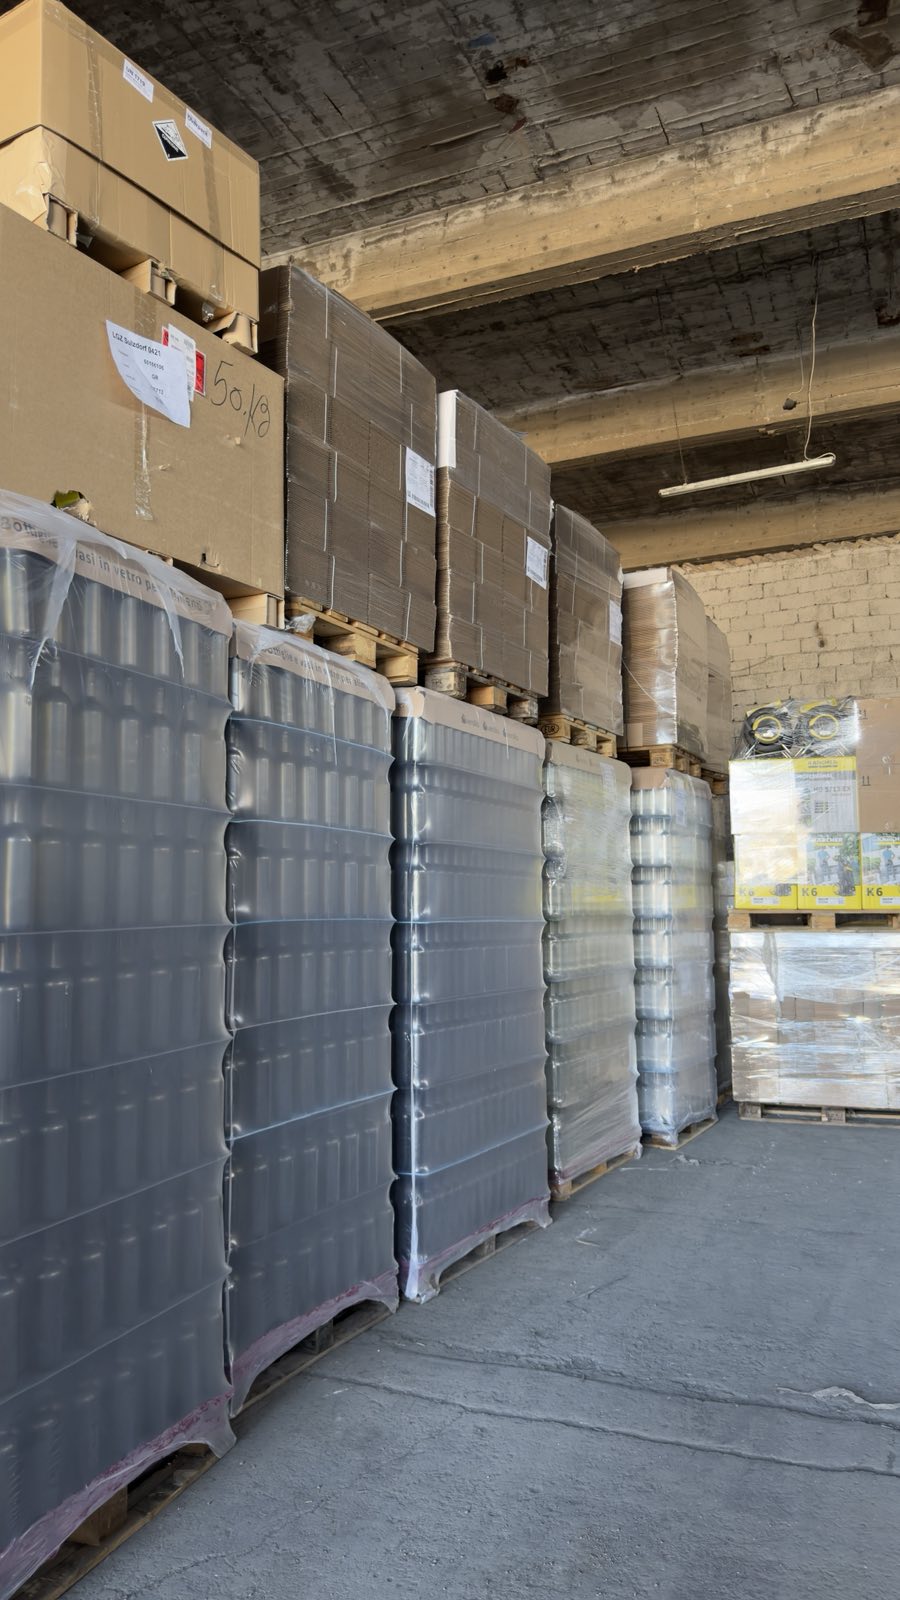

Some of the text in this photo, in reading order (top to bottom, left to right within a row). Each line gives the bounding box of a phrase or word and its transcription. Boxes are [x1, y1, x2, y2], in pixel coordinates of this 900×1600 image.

[112, 331, 124, 342] LGZ
[147, 345, 161, 357] 0421
[99, 555, 111, 572] in
[114, 565, 142, 586] vetro
[739, 888, 754, 897] K 6
[801, 887, 818, 897] K 6
[866, 887, 883, 896] K 6
